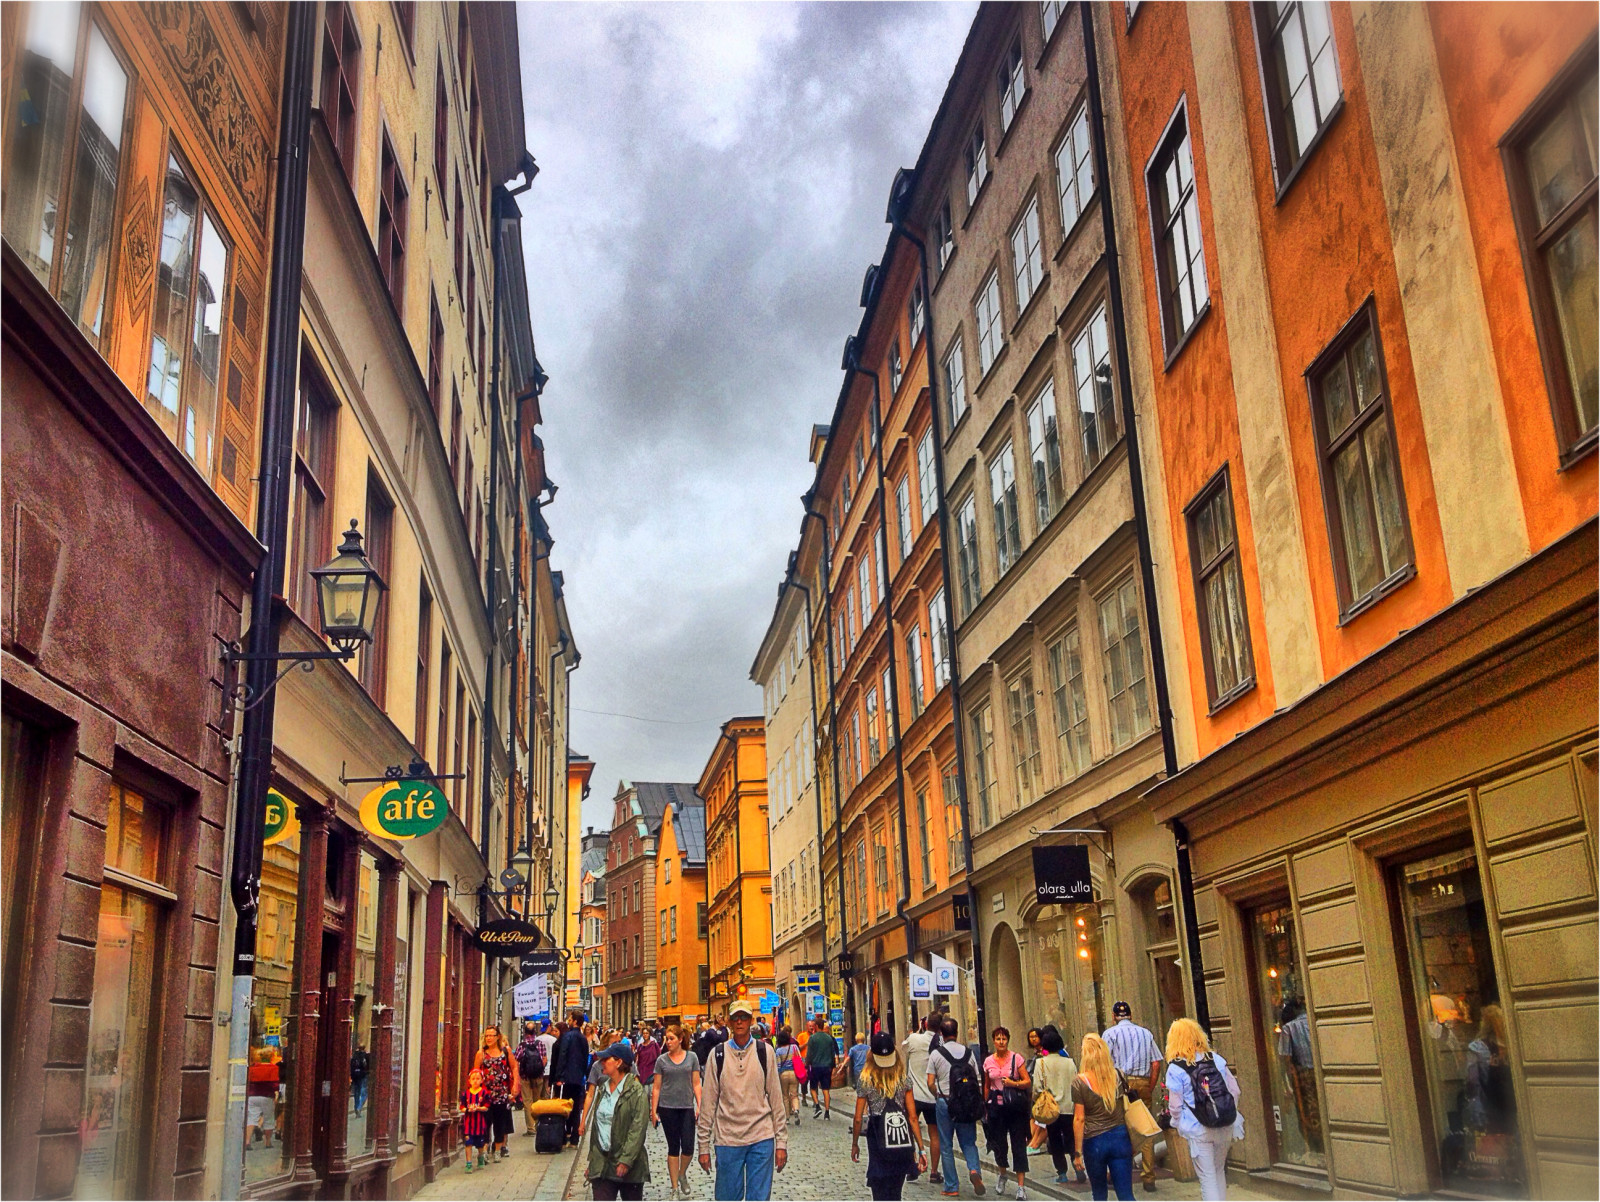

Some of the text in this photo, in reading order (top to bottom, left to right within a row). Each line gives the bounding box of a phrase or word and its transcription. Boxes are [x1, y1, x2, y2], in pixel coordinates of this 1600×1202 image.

[1038, 880, 1091, 895] olars ulla
[954, 905, 970, 919] 10
[840, 960, 852, 971] 10
